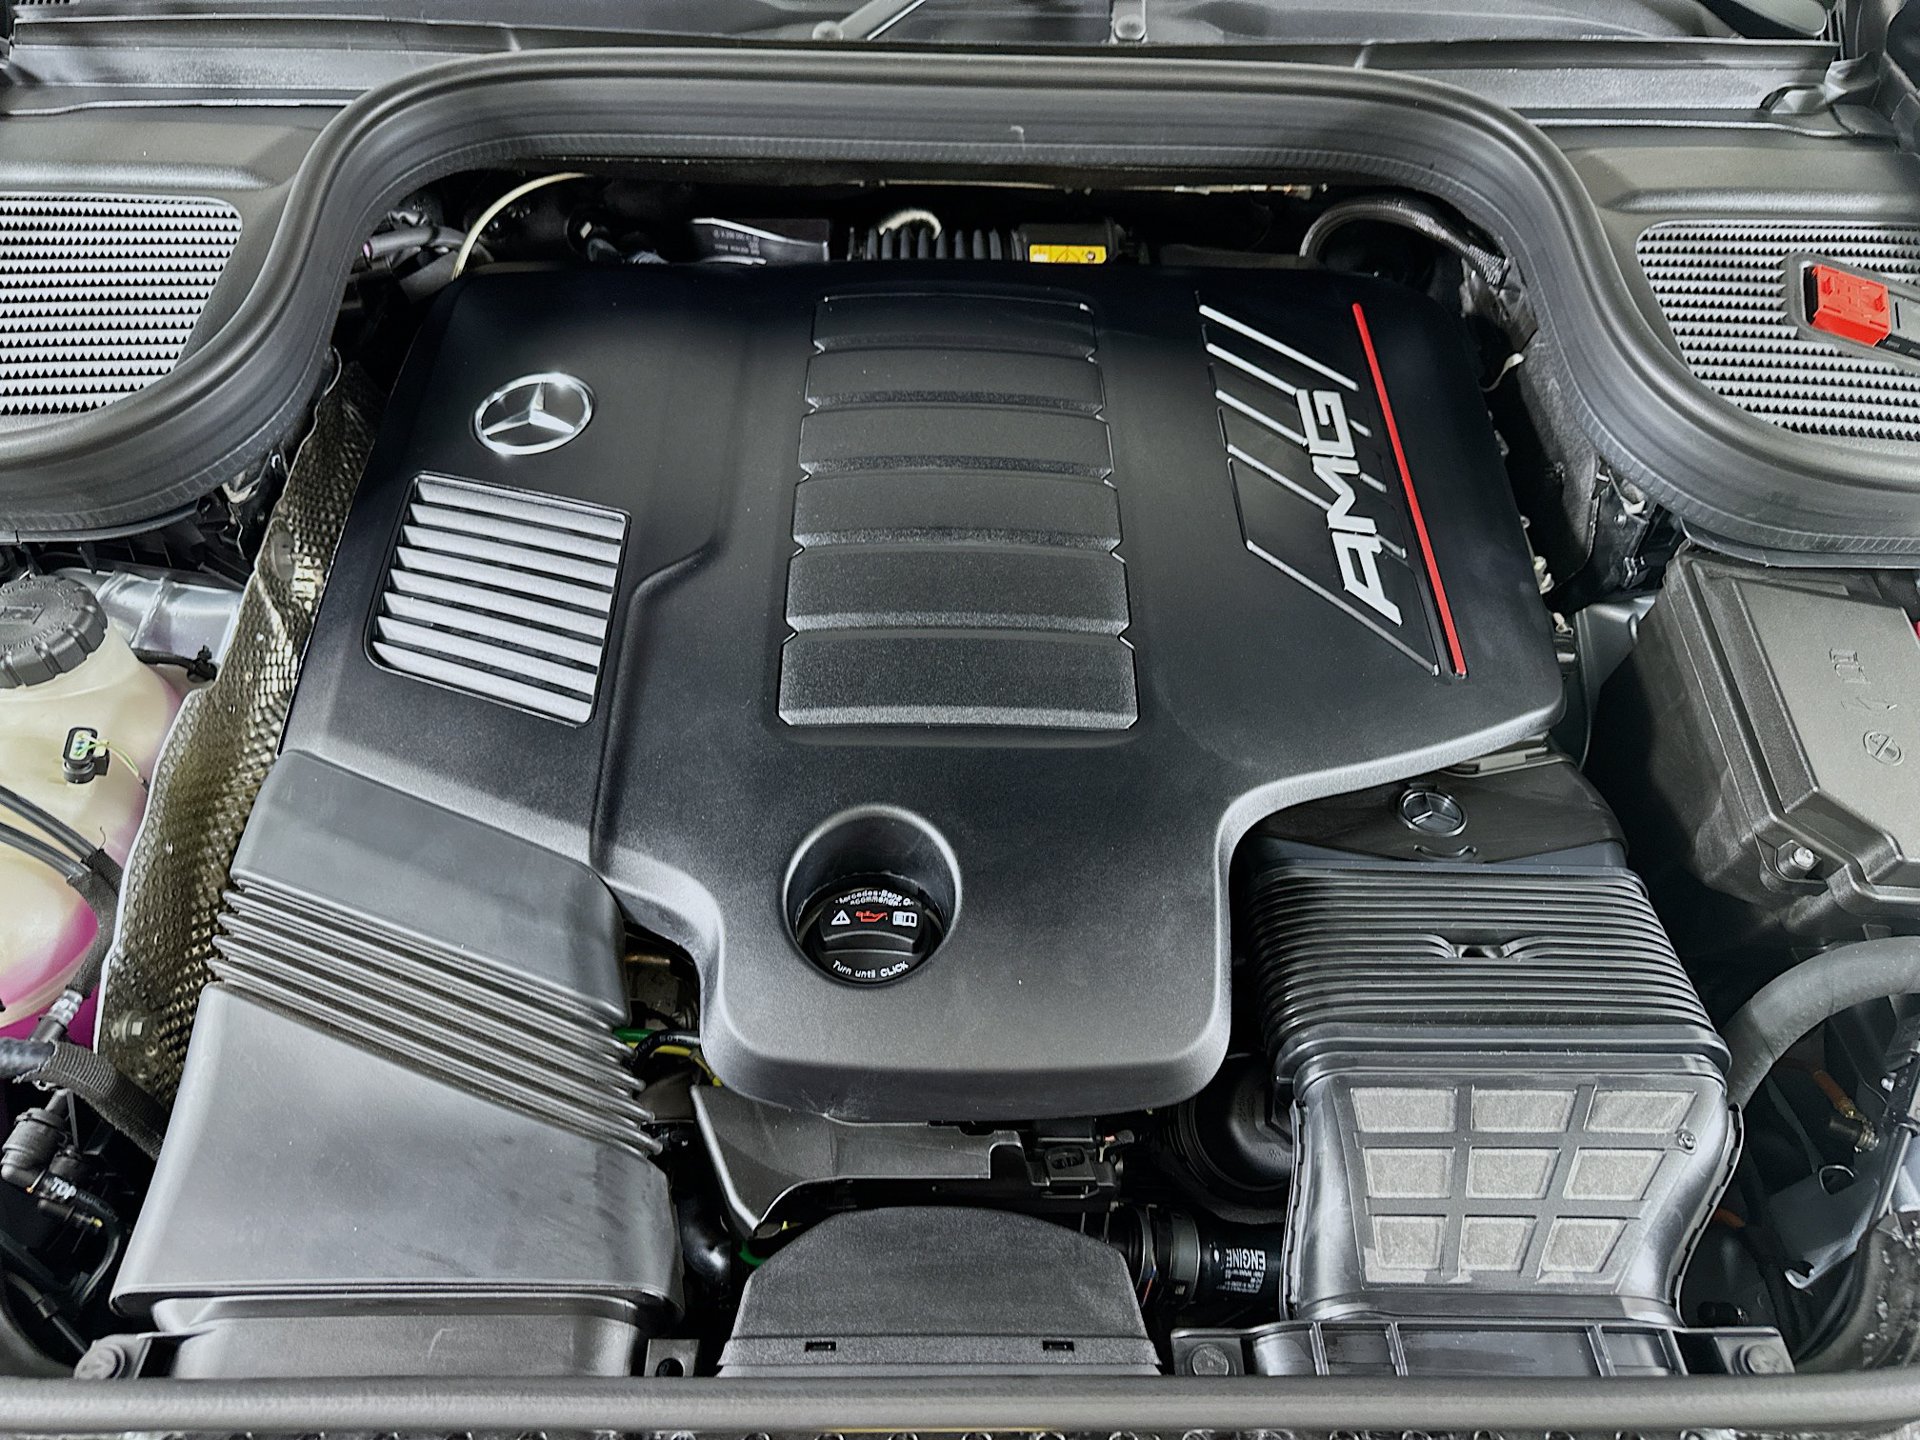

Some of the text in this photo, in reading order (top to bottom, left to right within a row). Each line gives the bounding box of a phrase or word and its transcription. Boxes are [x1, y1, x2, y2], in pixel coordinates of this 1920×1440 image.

[1296, 389, 1403, 626] AMG
[832, 960, 909, 978] Turn until CLICK
[50, 1176, 77, 1200] TOP
[1225, 1247, 1266, 1271] ENGINE
